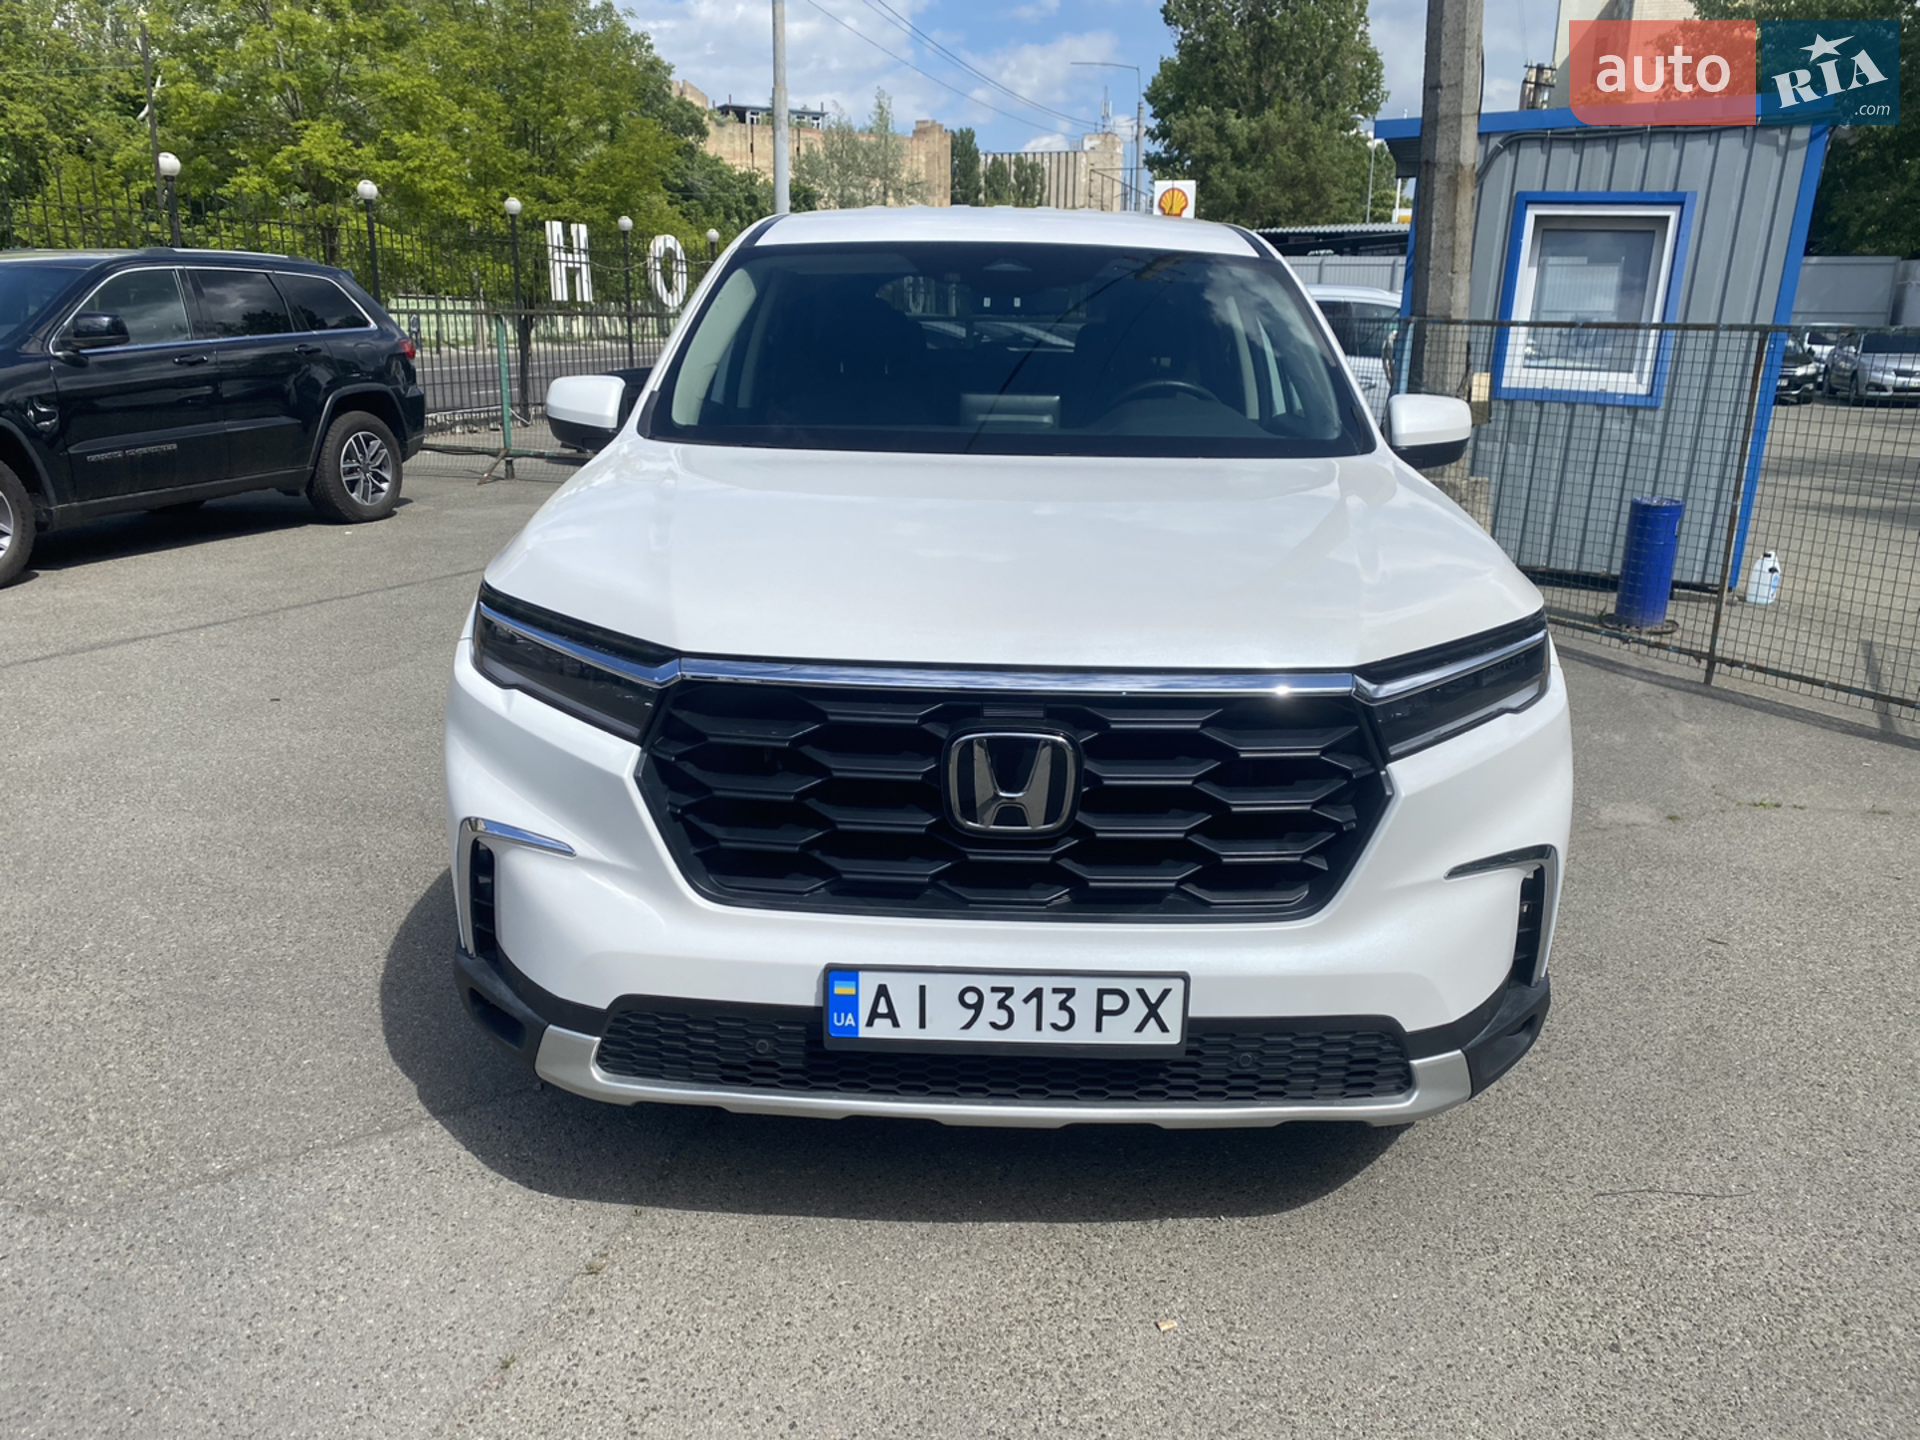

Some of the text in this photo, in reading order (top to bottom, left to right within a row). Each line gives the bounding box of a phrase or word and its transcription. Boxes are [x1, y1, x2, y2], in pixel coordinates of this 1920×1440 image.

[833, 1012, 856, 1028] UA
[865, 983, 1173, 1034] AI 9313 PX
